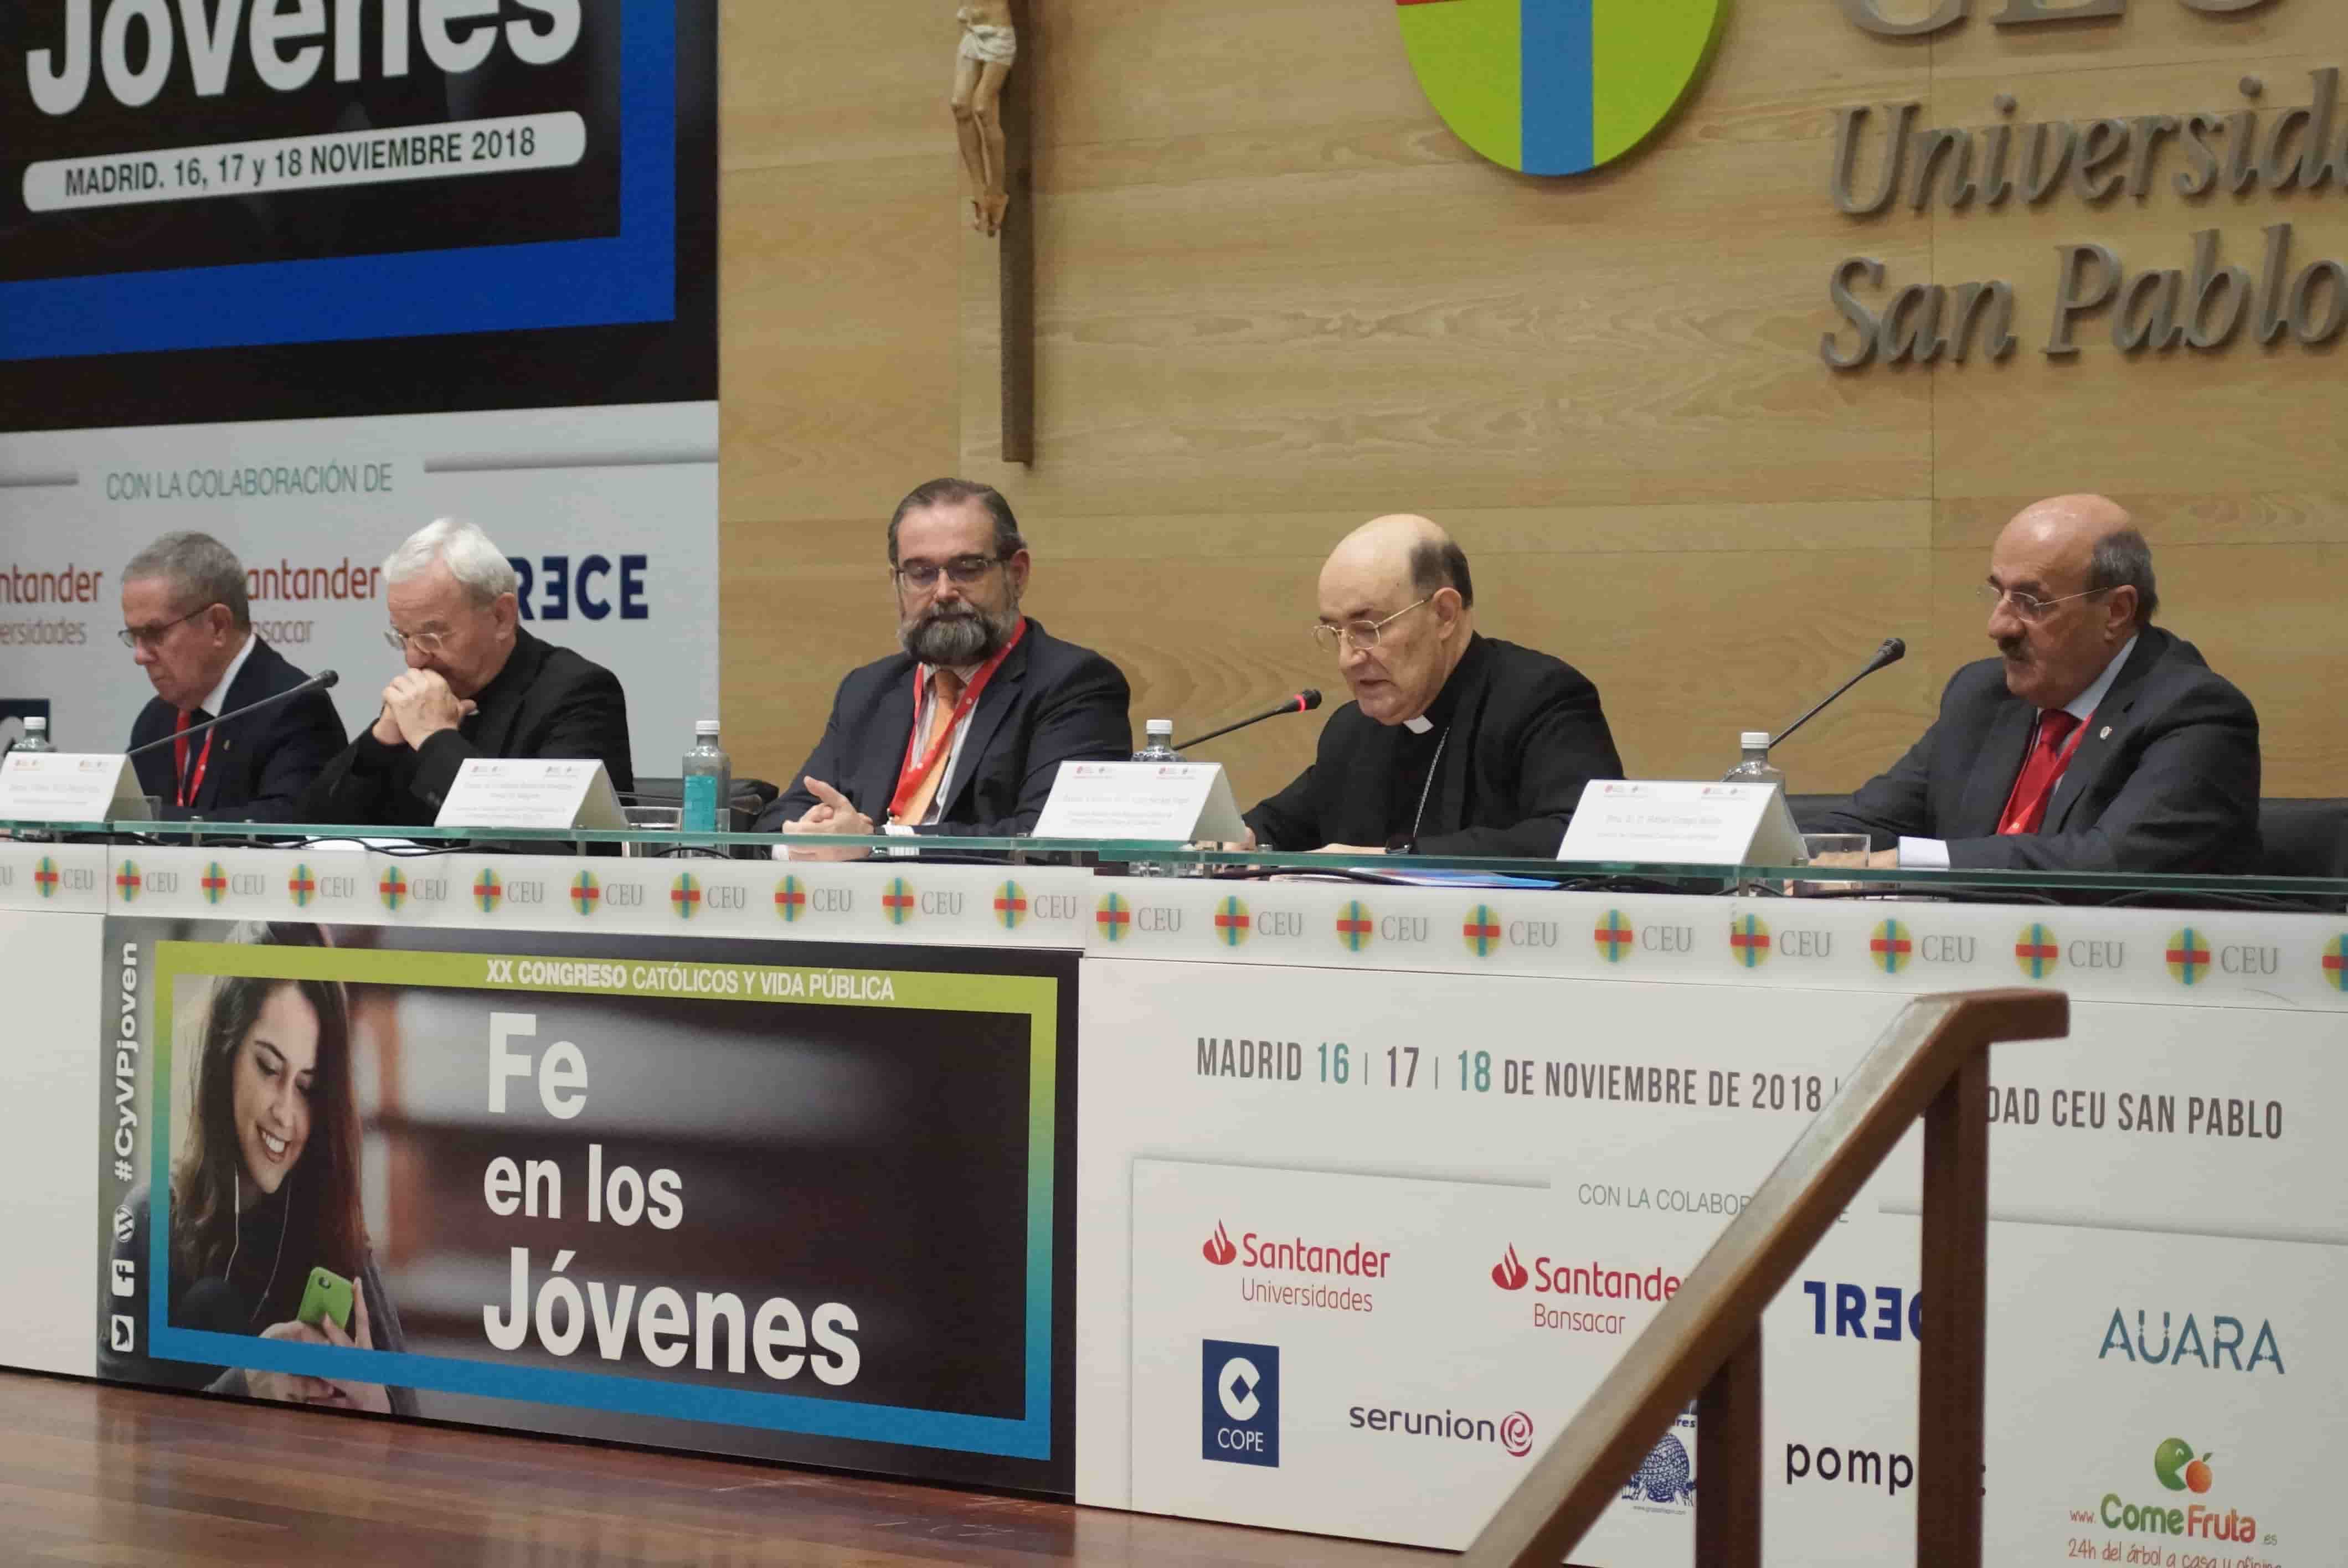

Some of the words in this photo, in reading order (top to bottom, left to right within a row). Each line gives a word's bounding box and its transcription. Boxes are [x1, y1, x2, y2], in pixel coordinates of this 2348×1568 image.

[65, 152, 165, 198] MADRID.
[174, 158, 208, 194] 16,
[219, 154, 244, 184] 17
[252, 161, 266, 187] y
[274, 147, 303, 178] 18
[310, 133, 463, 176] NOVIEMBRE
[471, 126, 535, 161] 2018
[1821, 256, 2017, 369] San
[2040, 223, 2348, 360] Pablo
[106, 472, 151, 501] CON
[158, 470, 182, 498] LA
[187, 459, 357, 497] COLABORACIÓN
[364, 462, 393, 493] DE
[62, 869, 94, 890] CEU
[146, 871, 178, 893] CEU
[231, 874, 265, 895] CEU
[320, 876, 354, 898] CEU
[412, 879, 447, 901] CEU
[507, 881, 544, 904] CEU
[606, 884, 643, 906] CEU
[707, 886, 745, 909] CEU
[812, 888, 852, 912] CEU
[921, 891, 963, 915] CEU
[1034, 895, 1078, 919] CEU
[1137, 907, 1182, 933] CEU
[1258, 911, 1302, 937] CEU
[1381, 915, 1429, 942] CEU
[1509, 920, 1558, 947] CEU
[1642, 925, 1693, 952] CEU
[1780, 930, 1832, 958] CEU
[1922, 935, 1976, 963] CEU
[2068, 940, 2125, 969] CEU
[2221, 945, 2279, 974] CEU
[486, 960, 513, 984] XX
[519, 961, 627, 989] CONGRESO
[632, 962, 738, 994] CATÓLICOS
[745, 972, 756, 995] Y
[760, 972, 806, 997] VIDA
[810, 968, 895, 1001] PÚBLICA
[114, 942, 138, 1182] #CyVPjoven
[488, 1012, 588, 1120] Fe
[1197, 1037, 1302, 1081] MADRID
[1317, 1042, 1350, 1085] 16
[1387, 1046, 1419, 1089] 17
[1458, 1050, 1491, 1092] 18
[1504, 1059, 1535, 1096] DE
[1546, 1061, 1697, 1105] NOVIEMBRE
[1708, 1070, 1741, 1108] DE
[1752, 1072, 1822, 1112] 2018
[2052, 1089, 2105, 1130] CEU
[2118, 1092, 2175, 1133] SAN
[2189, 1096, 2283, 1139] PABLO
[484, 1156, 561, 1219] en
[588, 1143, 683, 1230] los
[1578, 1183, 1620, 1207] CON
[1627, 1188, 1650, 1209] LA
[1242, 1232, 1391, 1278] Santander
[1242, 1277, 1373, 1313] Universidades
[483, 1246, 861, 1386] Jóvenes
[1534, 1303, 1626, 1335] Bansacar
[2098, 1307, 2285, 1375] AUARA
[1348, 1405, 1495, 1442] serunion
[1218, 1427, 1264, 1452] COPE
[1786, 1441, 1913, 1496] pomp
[2069, 1510, 2096, 1524] www.
[2068, 1537, 2096, 1560] 24h
[2103, 1541, 2122, 1562] del
[2127, 1544, 2161, 1567] árbol
[2166, 1552, 2176, 1568] a
[2182, 1554, 2216, 1568] casa
